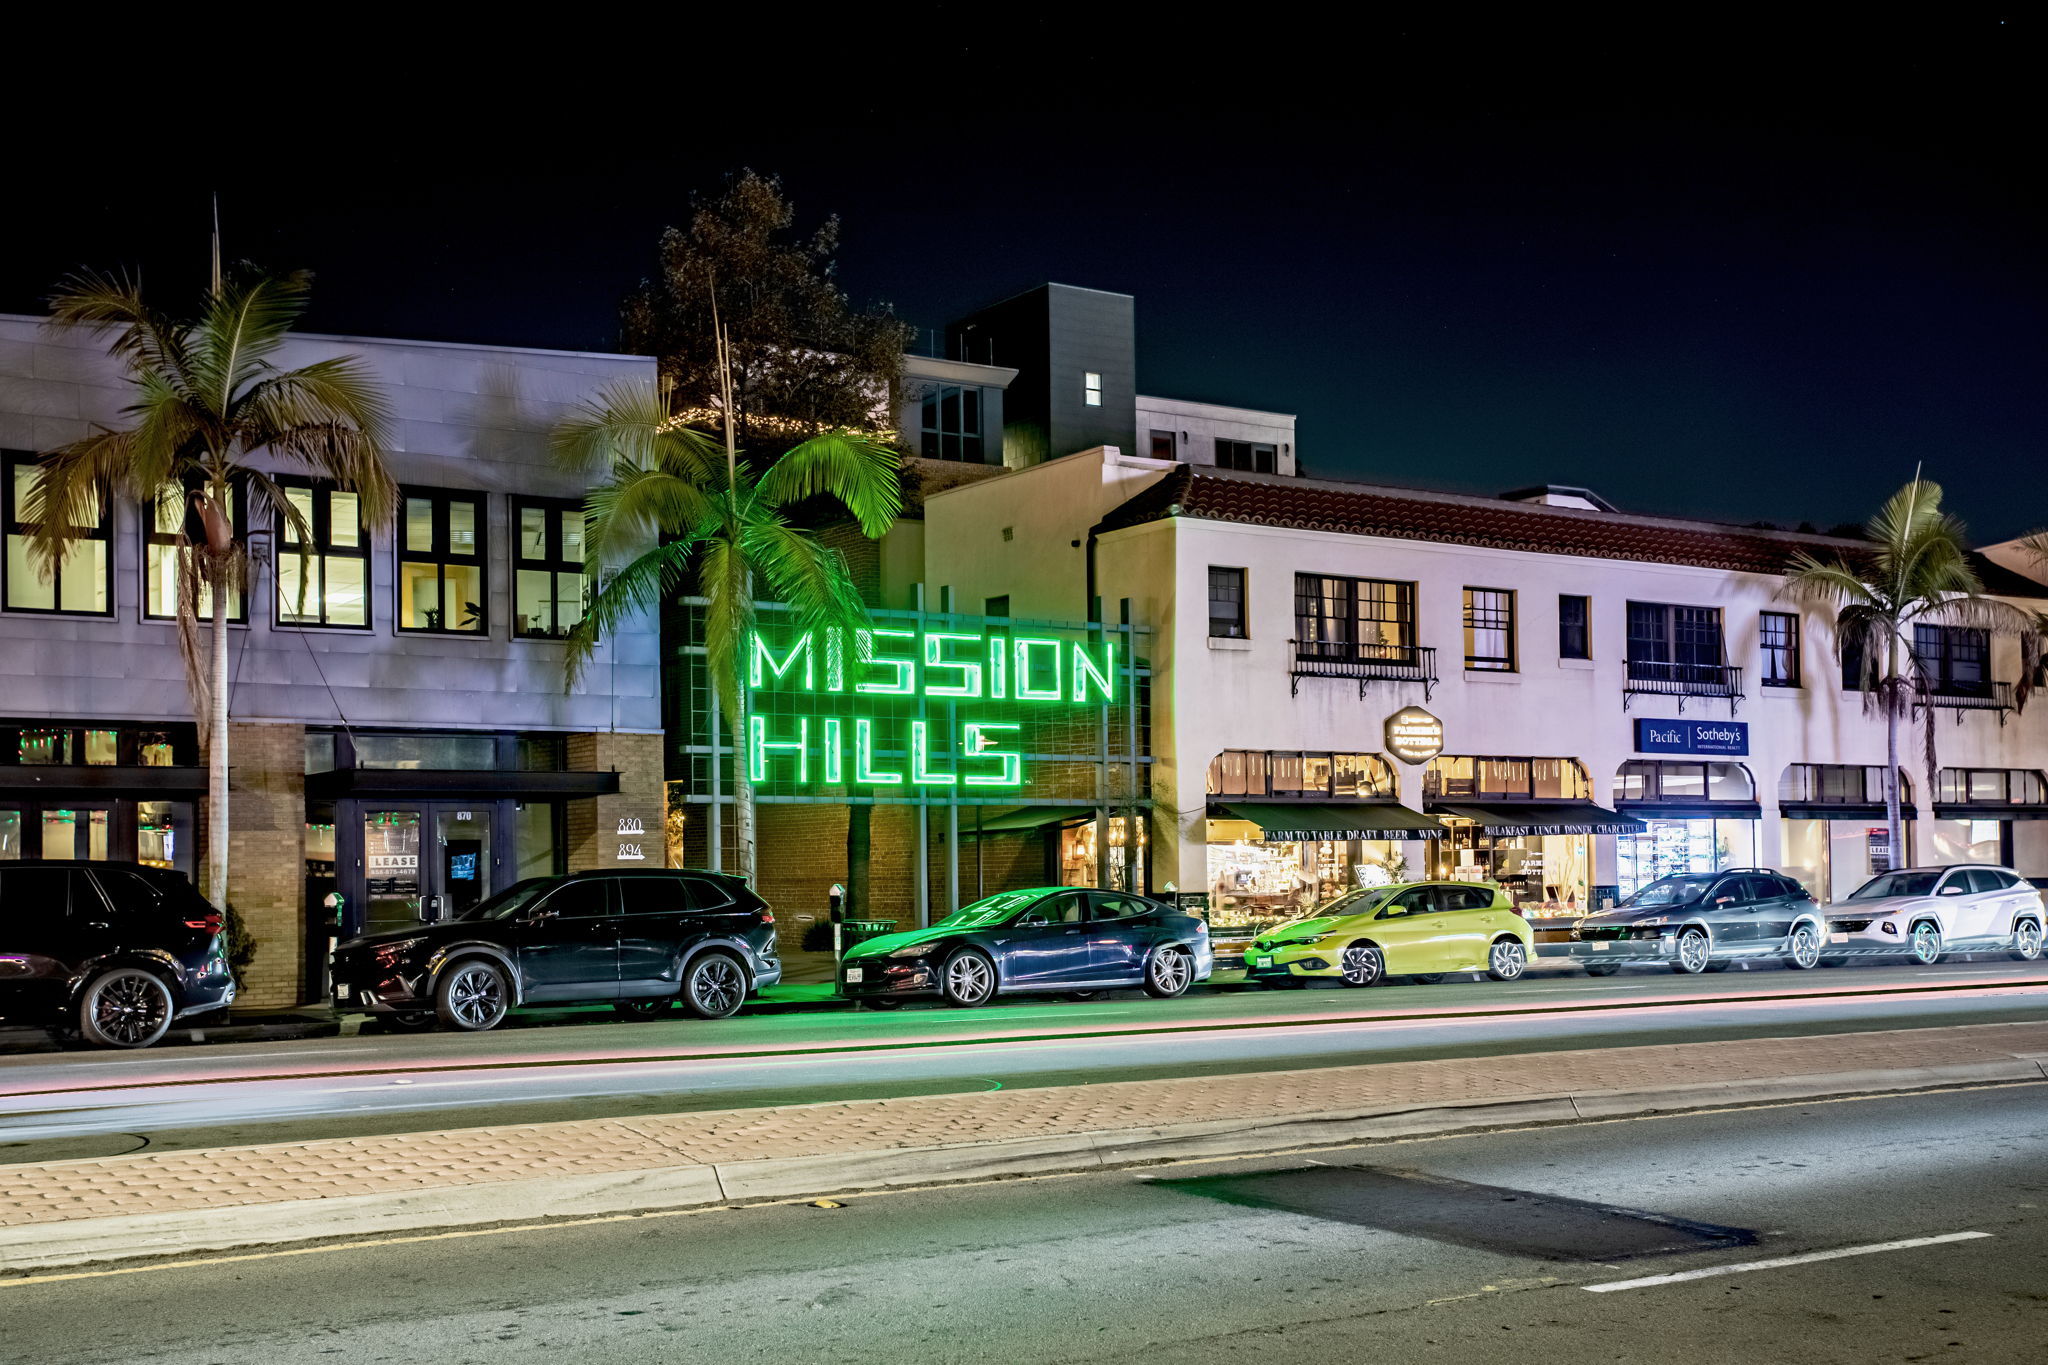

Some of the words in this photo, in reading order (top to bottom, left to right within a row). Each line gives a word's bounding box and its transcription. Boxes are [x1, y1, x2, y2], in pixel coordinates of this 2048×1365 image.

[749, 626, 1113, 702] MISSION
[1650, 729, 1681, 743] Pacific
[1696, 726, 1741, 745] Sotheby's
[750, 715, 1021, 786] HILLS
[456, 811, 472, 821] 870
[618, 818, 642, 832] 880
[1485, 825, 1530, 836] BREAKFAST
[1534, 825, 1560, 836] LUNCH
[1564, 824, 1593, 835] DINNER
[1265, 830, 1294, 841] FARM
[1295, 830, 1310, 841] TO
[1311, 830, 1344, 841] TABLE
[1346, 829, 1378, 841] DRAFT
[1383, 829, 1408, 840] BEER
[618, 843, 642, 857] 894
[375, 857, 416, 866] LEASE
